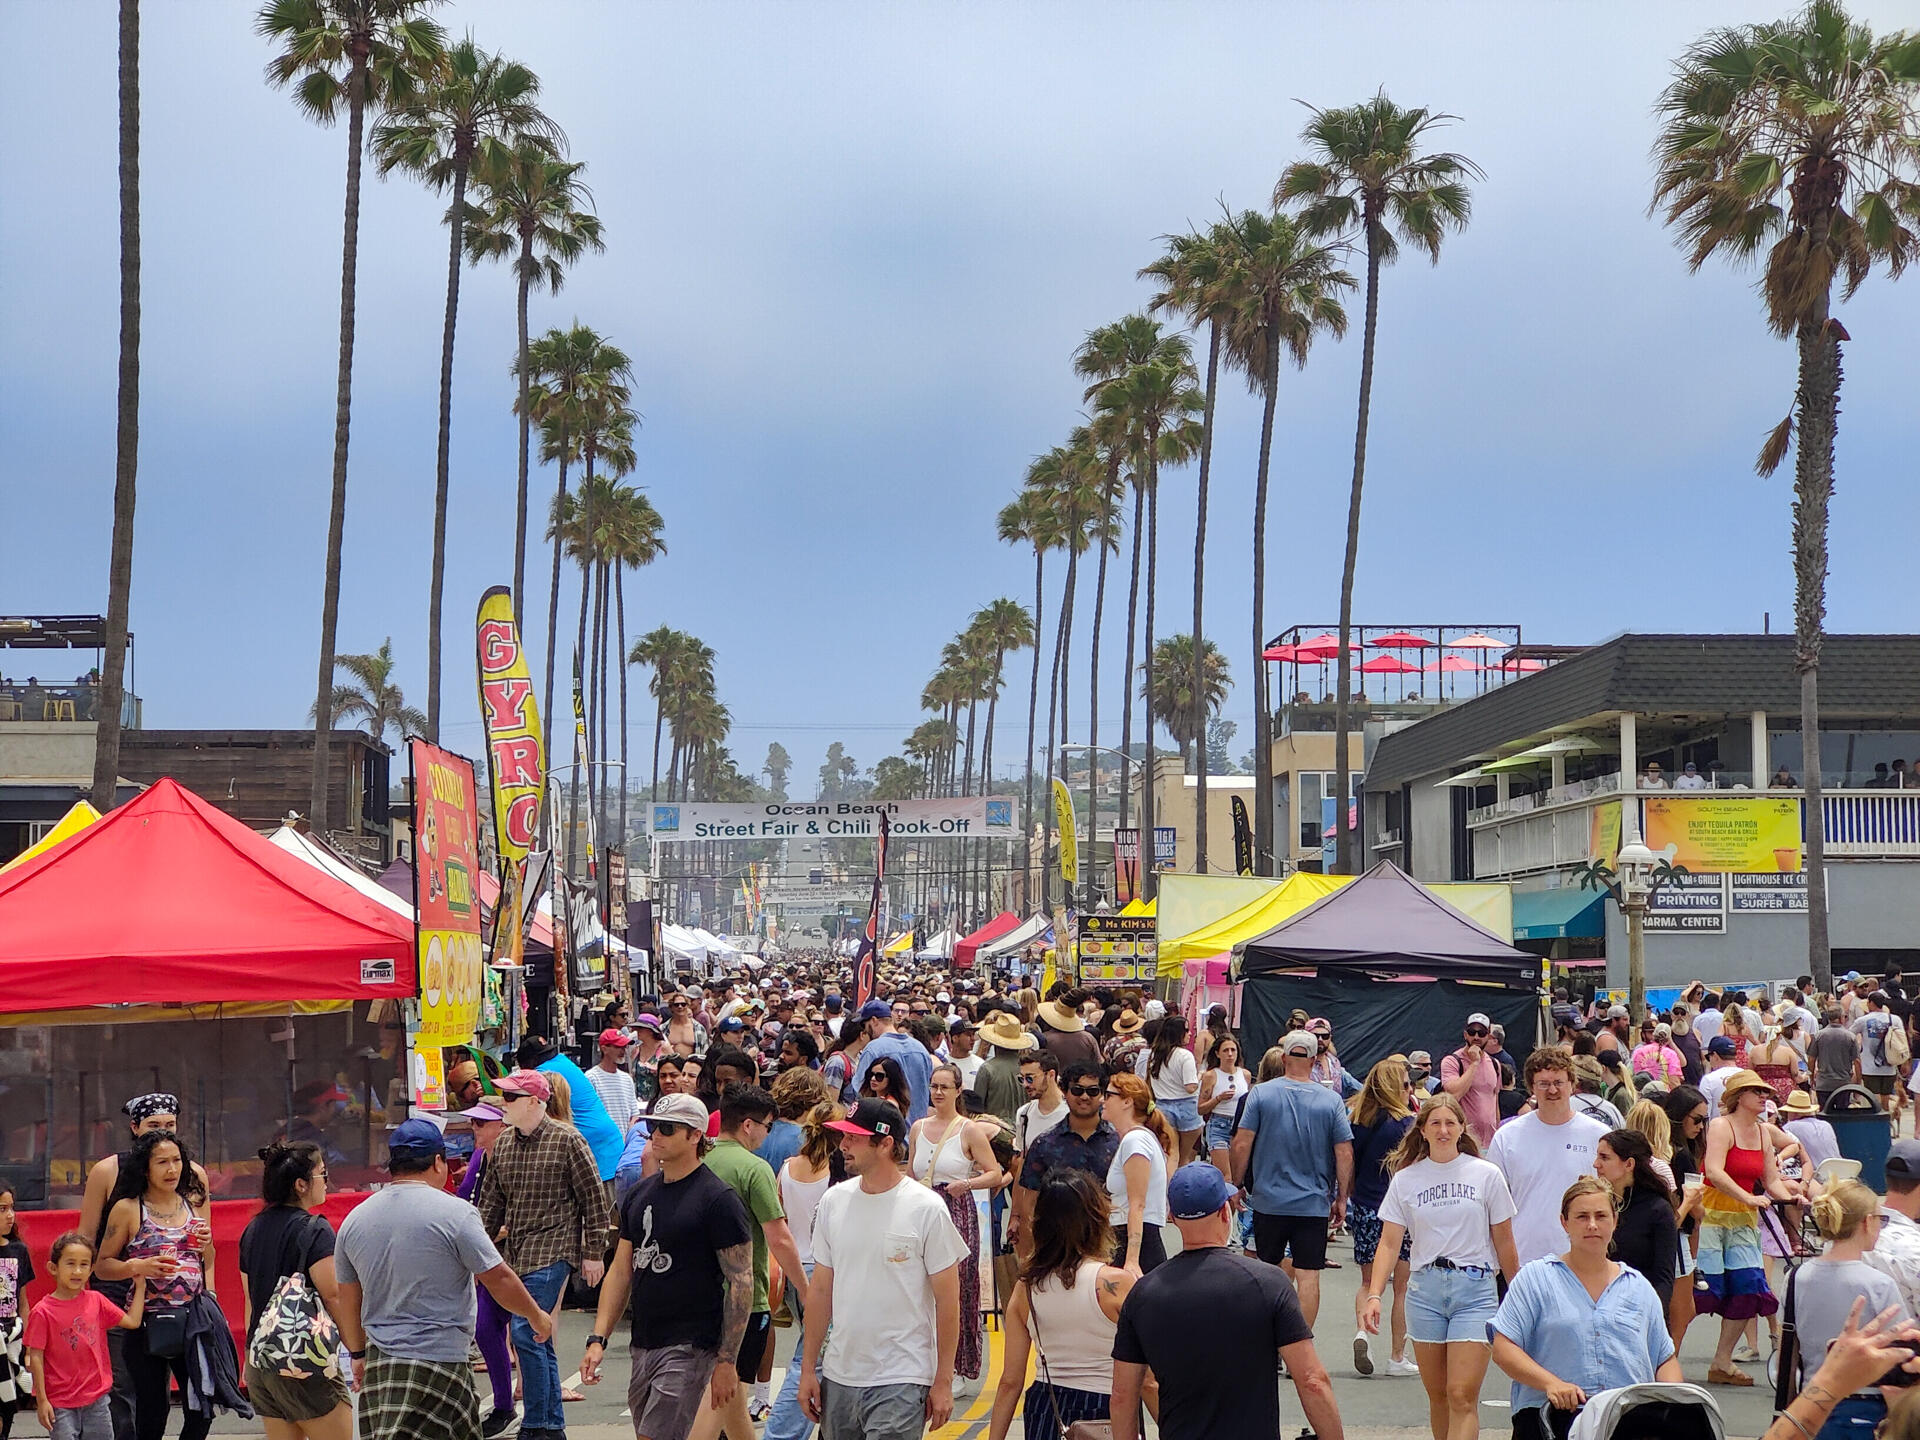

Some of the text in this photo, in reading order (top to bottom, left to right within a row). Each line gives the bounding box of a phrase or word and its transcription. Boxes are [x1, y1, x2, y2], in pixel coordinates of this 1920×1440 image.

[478, 619, 541, 850] GYRO
[765, 802, 899, 816] Ocean Beach
[694, 816, 971, 837] Street Fair & Chili ook-Off
[1688, 819, 1758, 829] ENJOY TEQUILA PATRÓN
[1117, 831, 1137, 844] HIGH
[1153, 830, 1174, 843] HIGH
[1117, 844, 1138, 858] TIDES
[1153, 844, 1174, 857] TIDES
[1698, 874, 1720, 885] GRILLE
[1734, 874, 1809, 885] LIGHTHOUSE ICE CR
[1657, 895, 1719, 906] PRINTING
[1741, 899, 1809, 908] SURFER BAB
[1120, 919, 1146, 929] KIM's
[1642, 917, 1720, 927] HARMA CENTER
[362, 968, 391, 979] Eurmax
[1416, 1182, 1477, 1207] TORCH LAKE
[1431, 1199, 1461, 1208] MICHIGAN
